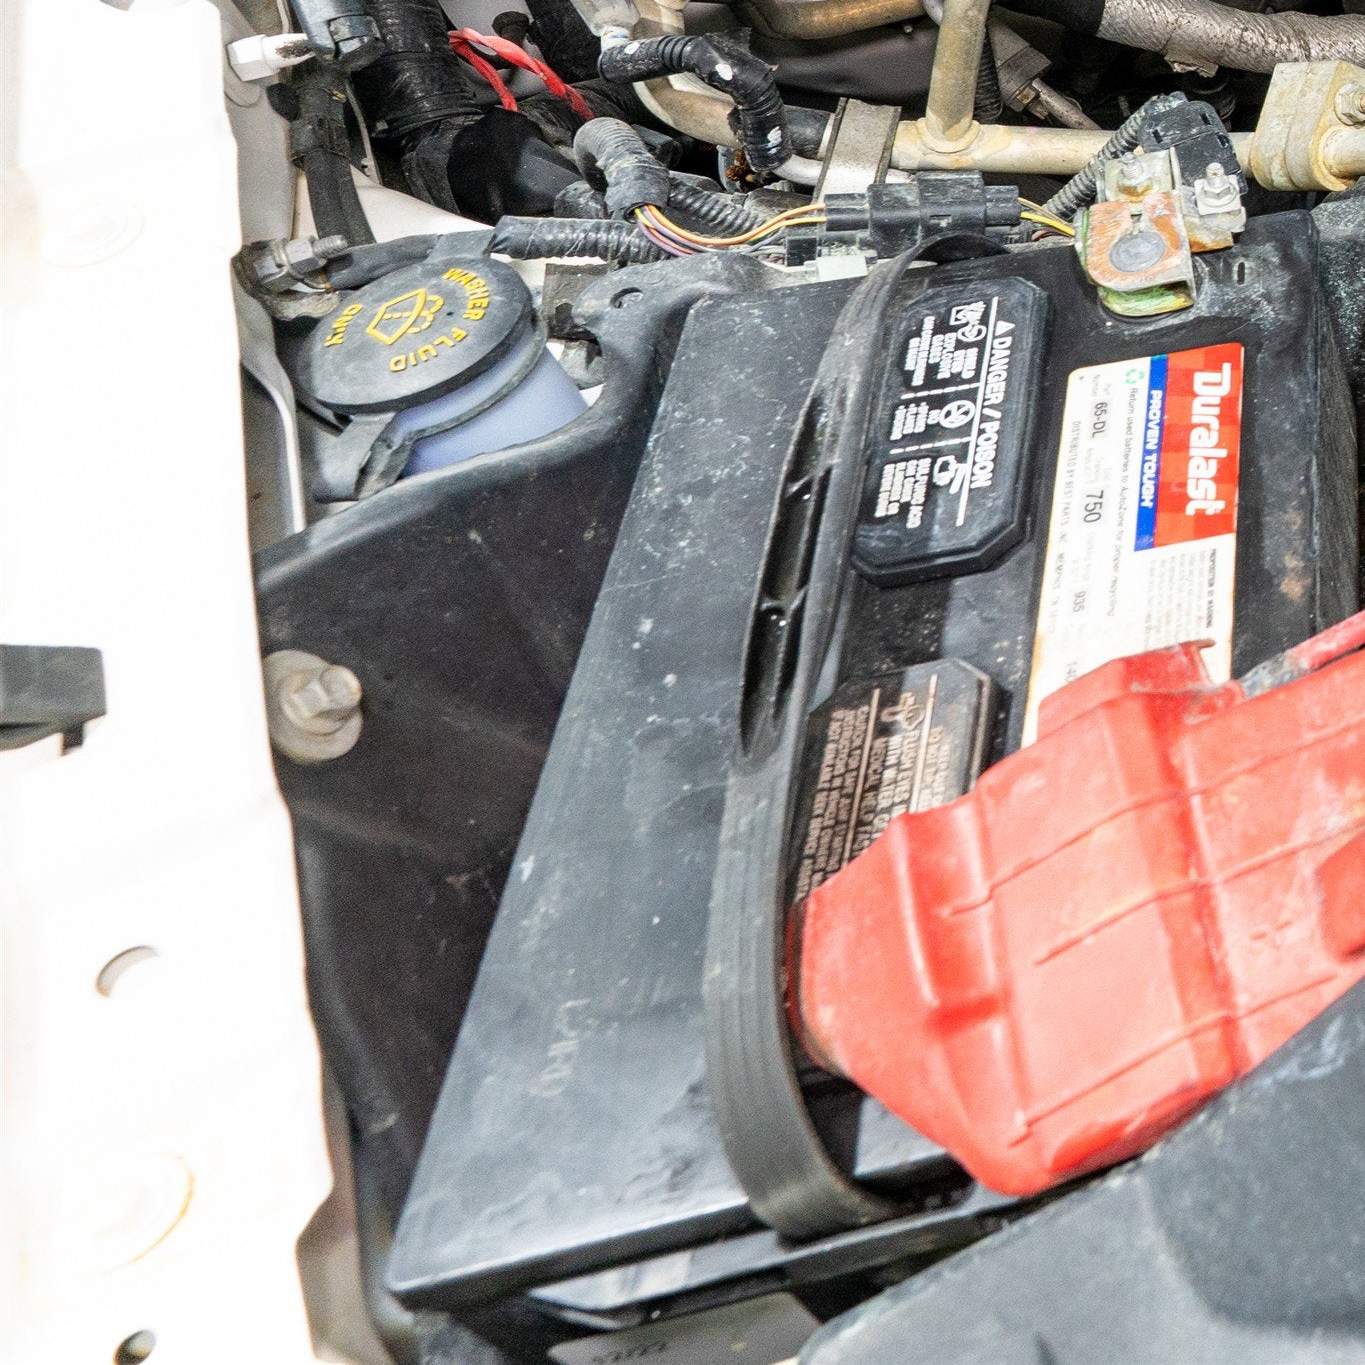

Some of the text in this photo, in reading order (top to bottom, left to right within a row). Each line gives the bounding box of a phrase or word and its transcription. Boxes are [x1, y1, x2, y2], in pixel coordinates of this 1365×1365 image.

[324, 268, 488, 372] WASHER FLUID ONLY
[983, 336, 1012, 406] DANGER
[1091, 400, 1107, 438] 65-DL
[1128, 387, 1137, 415] Return
[1066, 420, 1080, 468] DISTRIBUTED
[1126, 415, 1134, 435] used
[1186, 363, 1231, 516] Duralast
[970, 421, 1000, 489] POISON
[1122, 436, 1133, 472] batteries
[1140, 388, 1162, 508] PROVEN TOUGH
[1121, 474, 1128, 483] to
[1083, 489, 1103, 524] 750
[1117, 484, 1128, 527] AutoZone
[1072, 589, 1085, 613] 935
[886, 732, 902, 766] WITH
